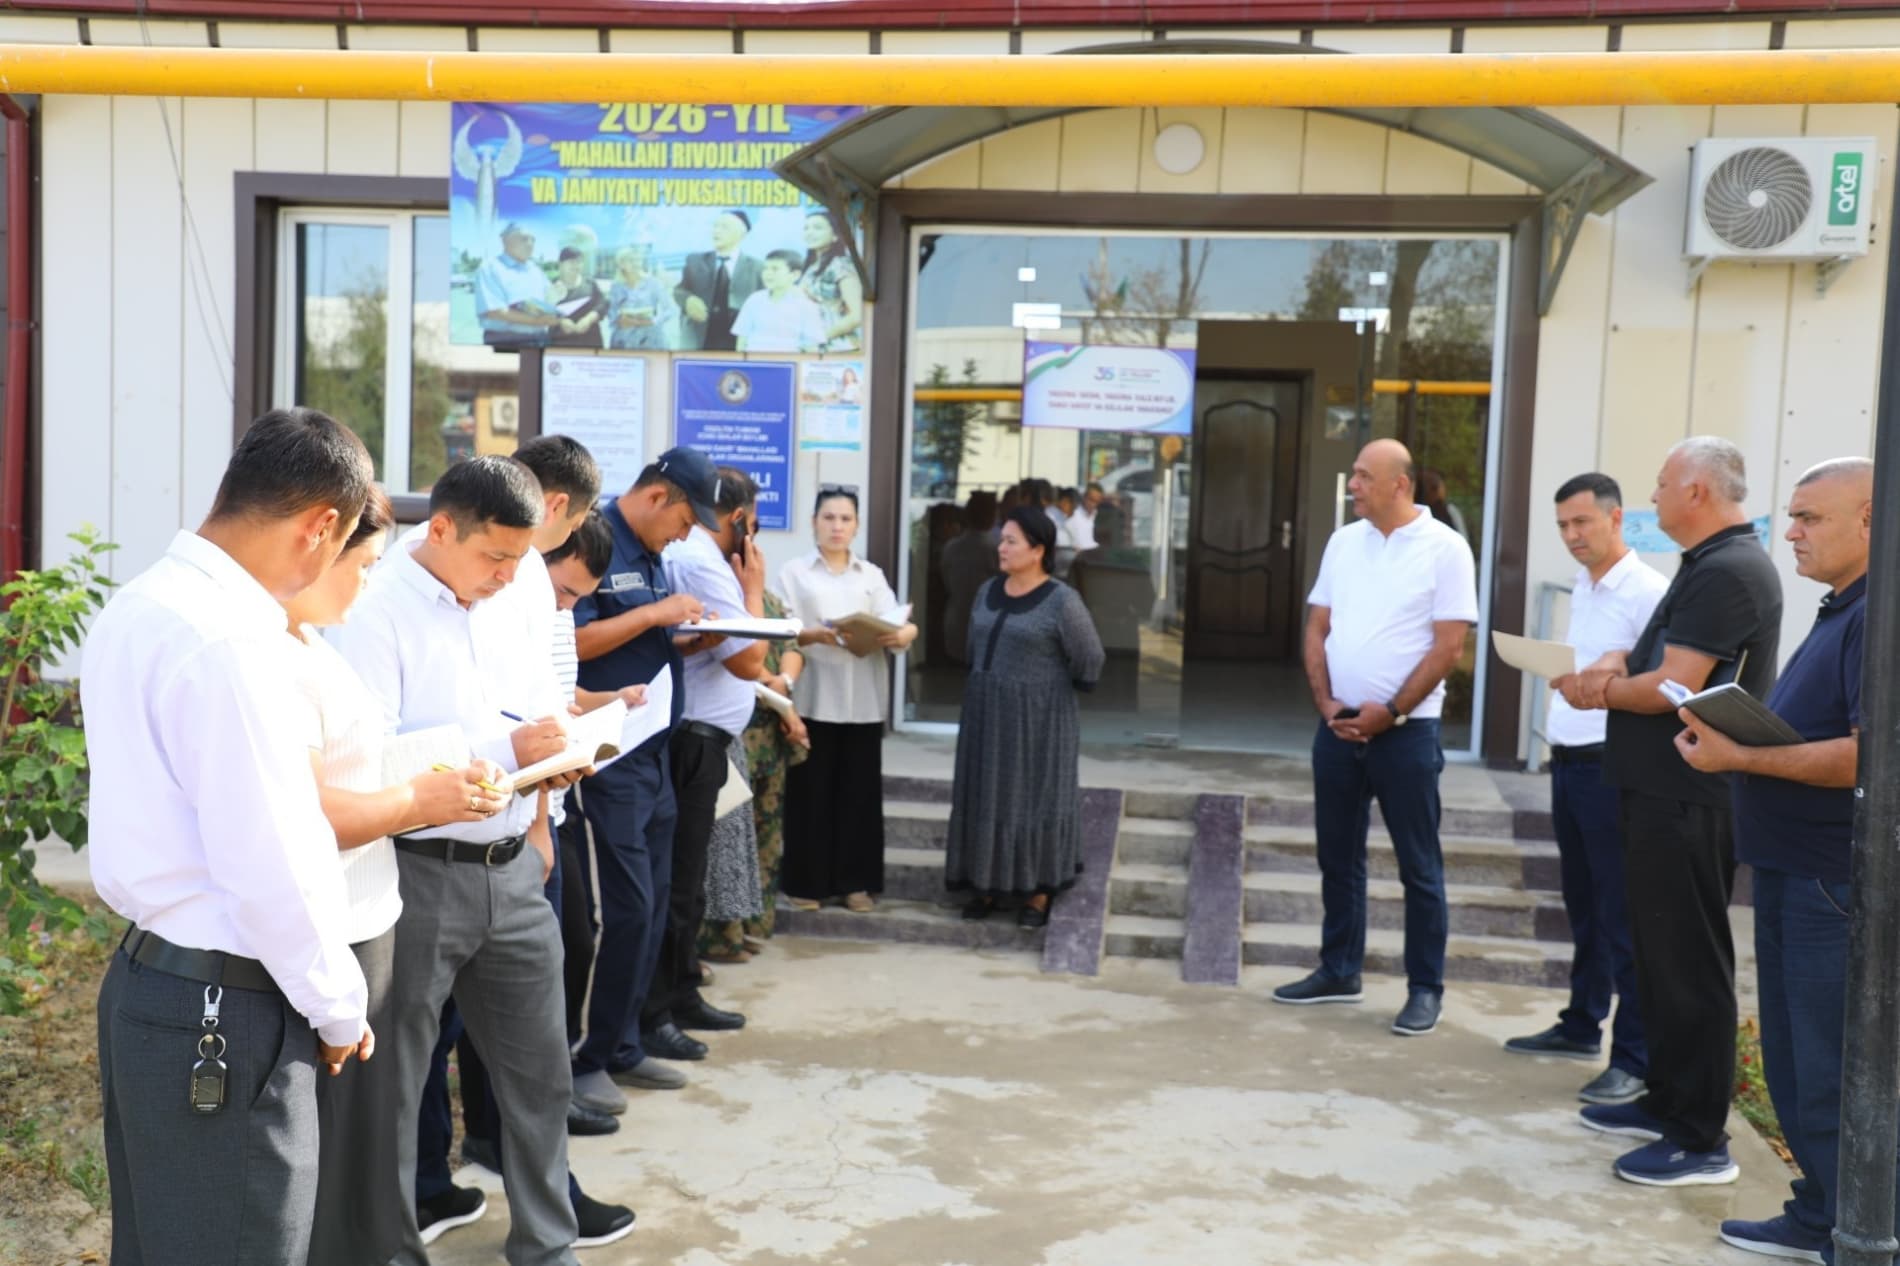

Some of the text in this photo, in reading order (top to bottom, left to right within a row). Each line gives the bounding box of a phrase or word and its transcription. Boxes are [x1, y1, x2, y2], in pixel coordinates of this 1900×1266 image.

[531, 176, 557, 204] VA
[560, 177, 658, 205] JAMIYATNI
[663, 178, 800, 206] YUKSALTIRISH
[1834, 165, 1858, 213] artel
